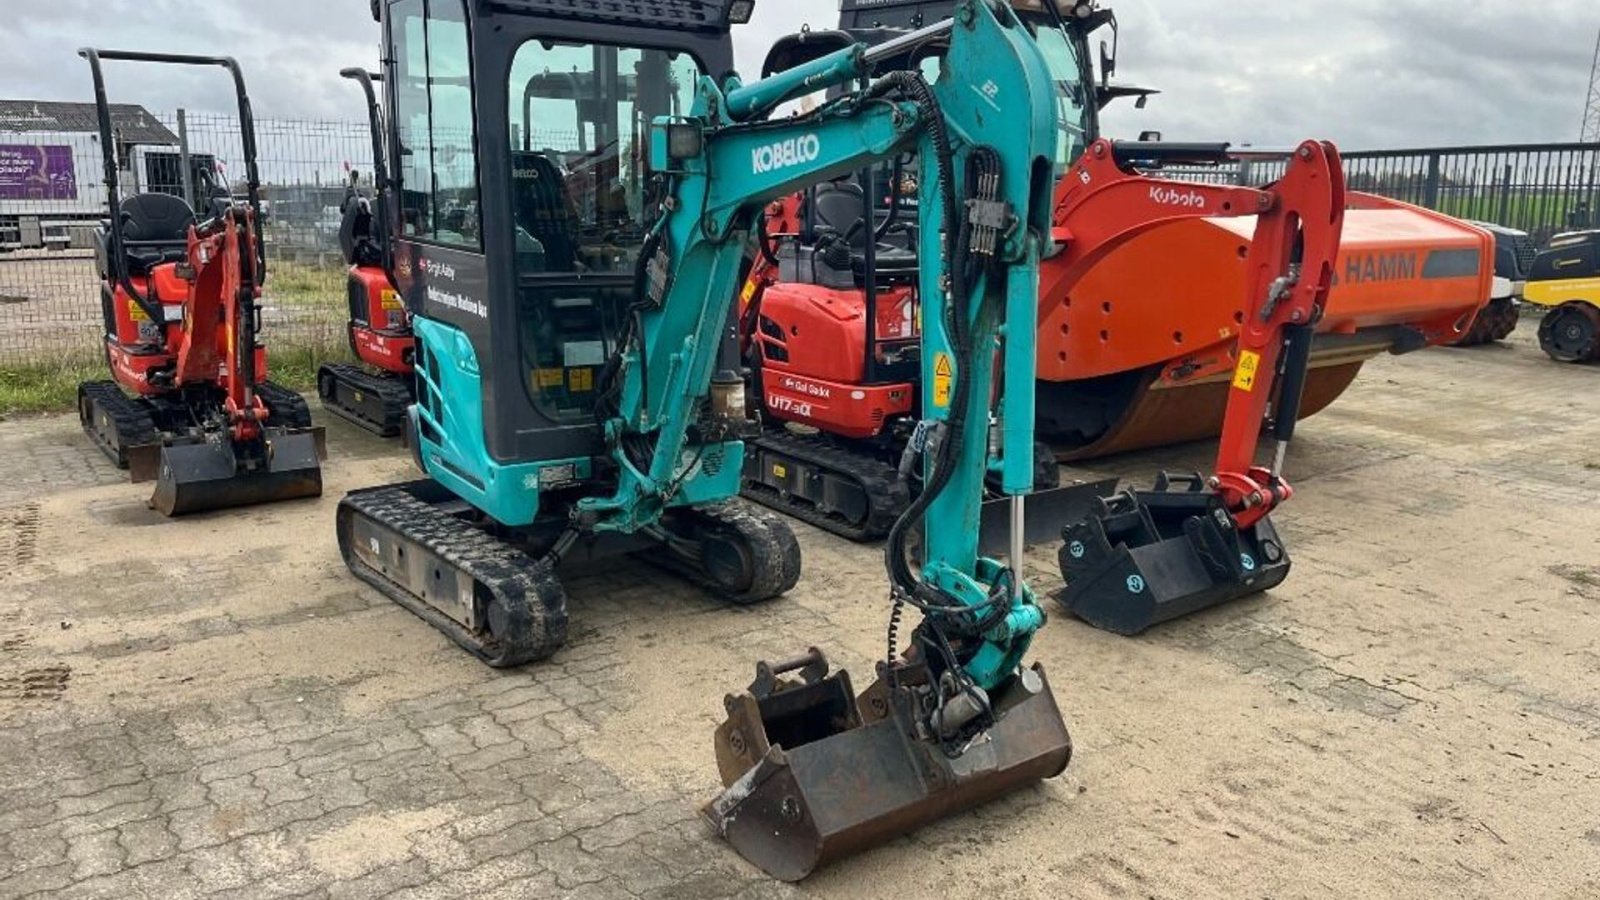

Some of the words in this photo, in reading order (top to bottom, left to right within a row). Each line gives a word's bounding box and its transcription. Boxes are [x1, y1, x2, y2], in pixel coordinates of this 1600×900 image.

[751, 133, 820, 175] KOBELCO
[1149, 186, 1205, 208] Kubota
[1344, 252, 1418, 284] HAMM
